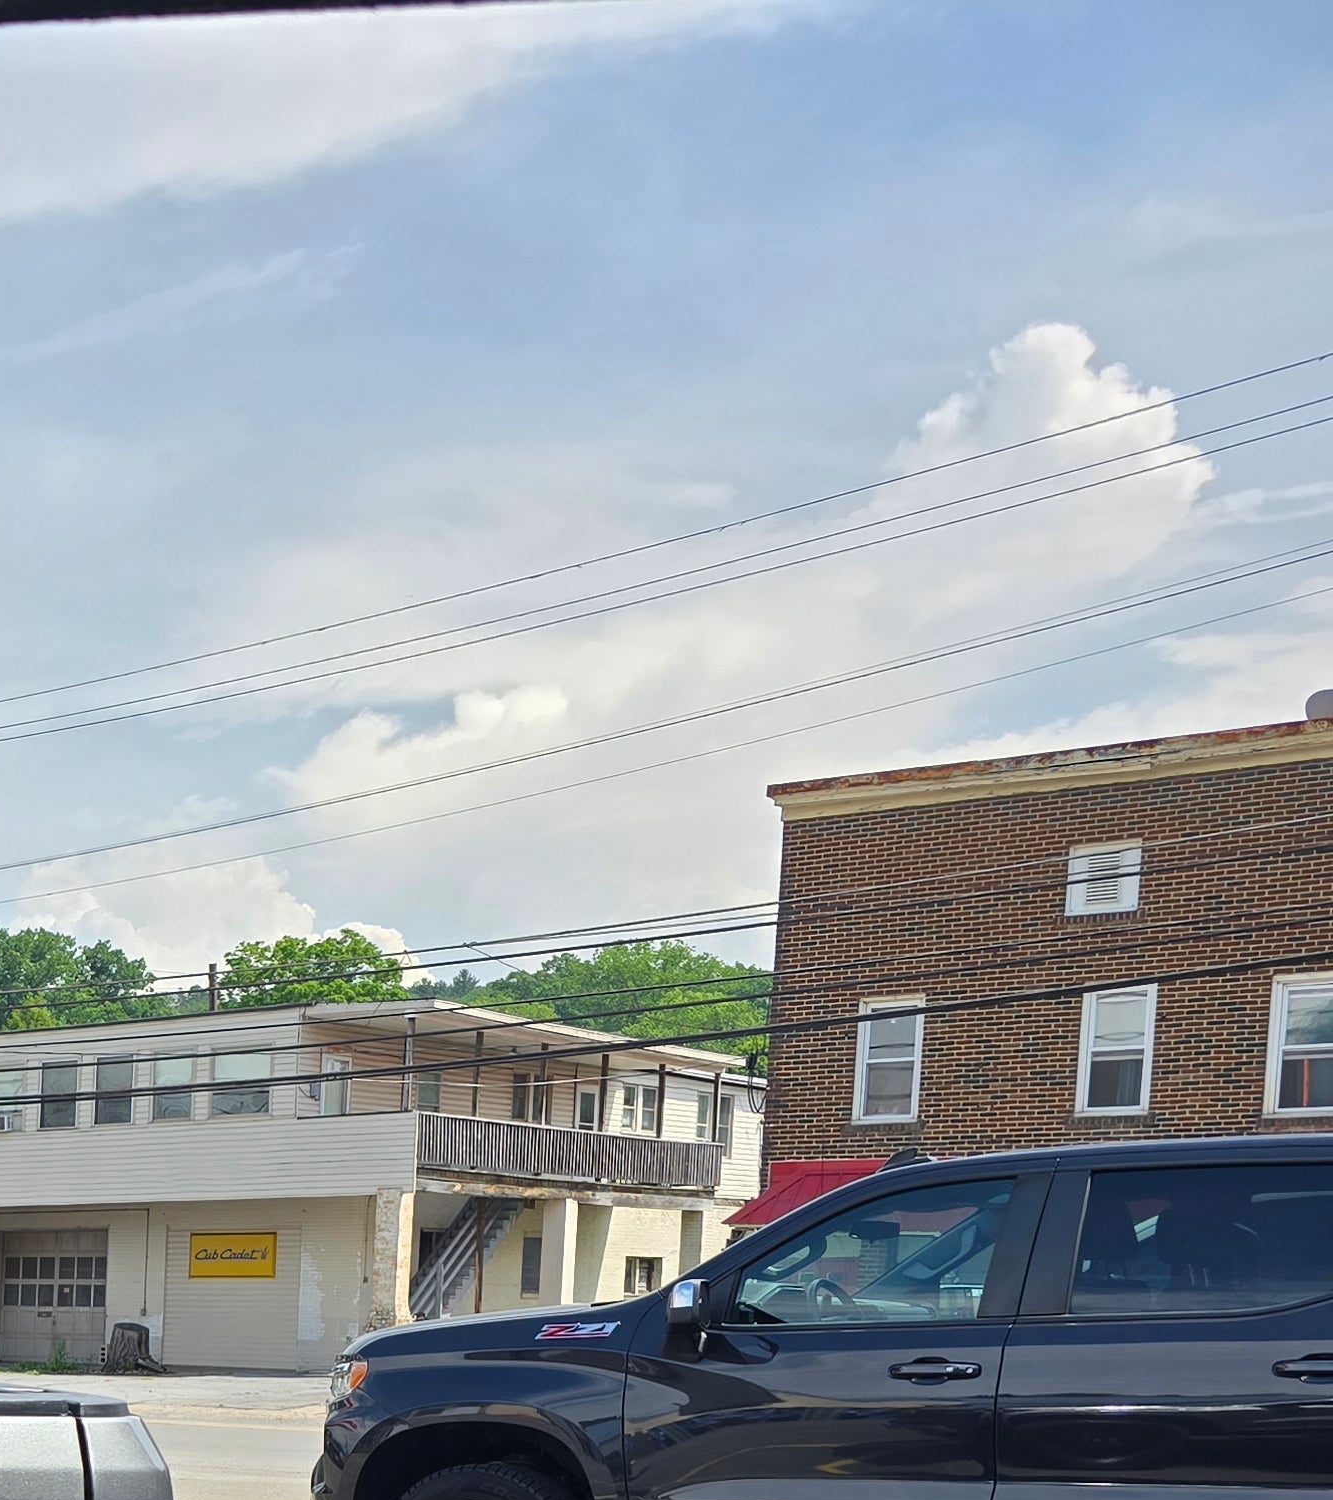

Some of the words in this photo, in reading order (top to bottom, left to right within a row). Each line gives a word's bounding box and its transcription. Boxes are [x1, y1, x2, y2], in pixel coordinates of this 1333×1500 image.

[195, 1248, 219, 1260] Cub
[220, 1248, 260, 1260] Cadet
[534, 1320, 621, 1340] Z71
